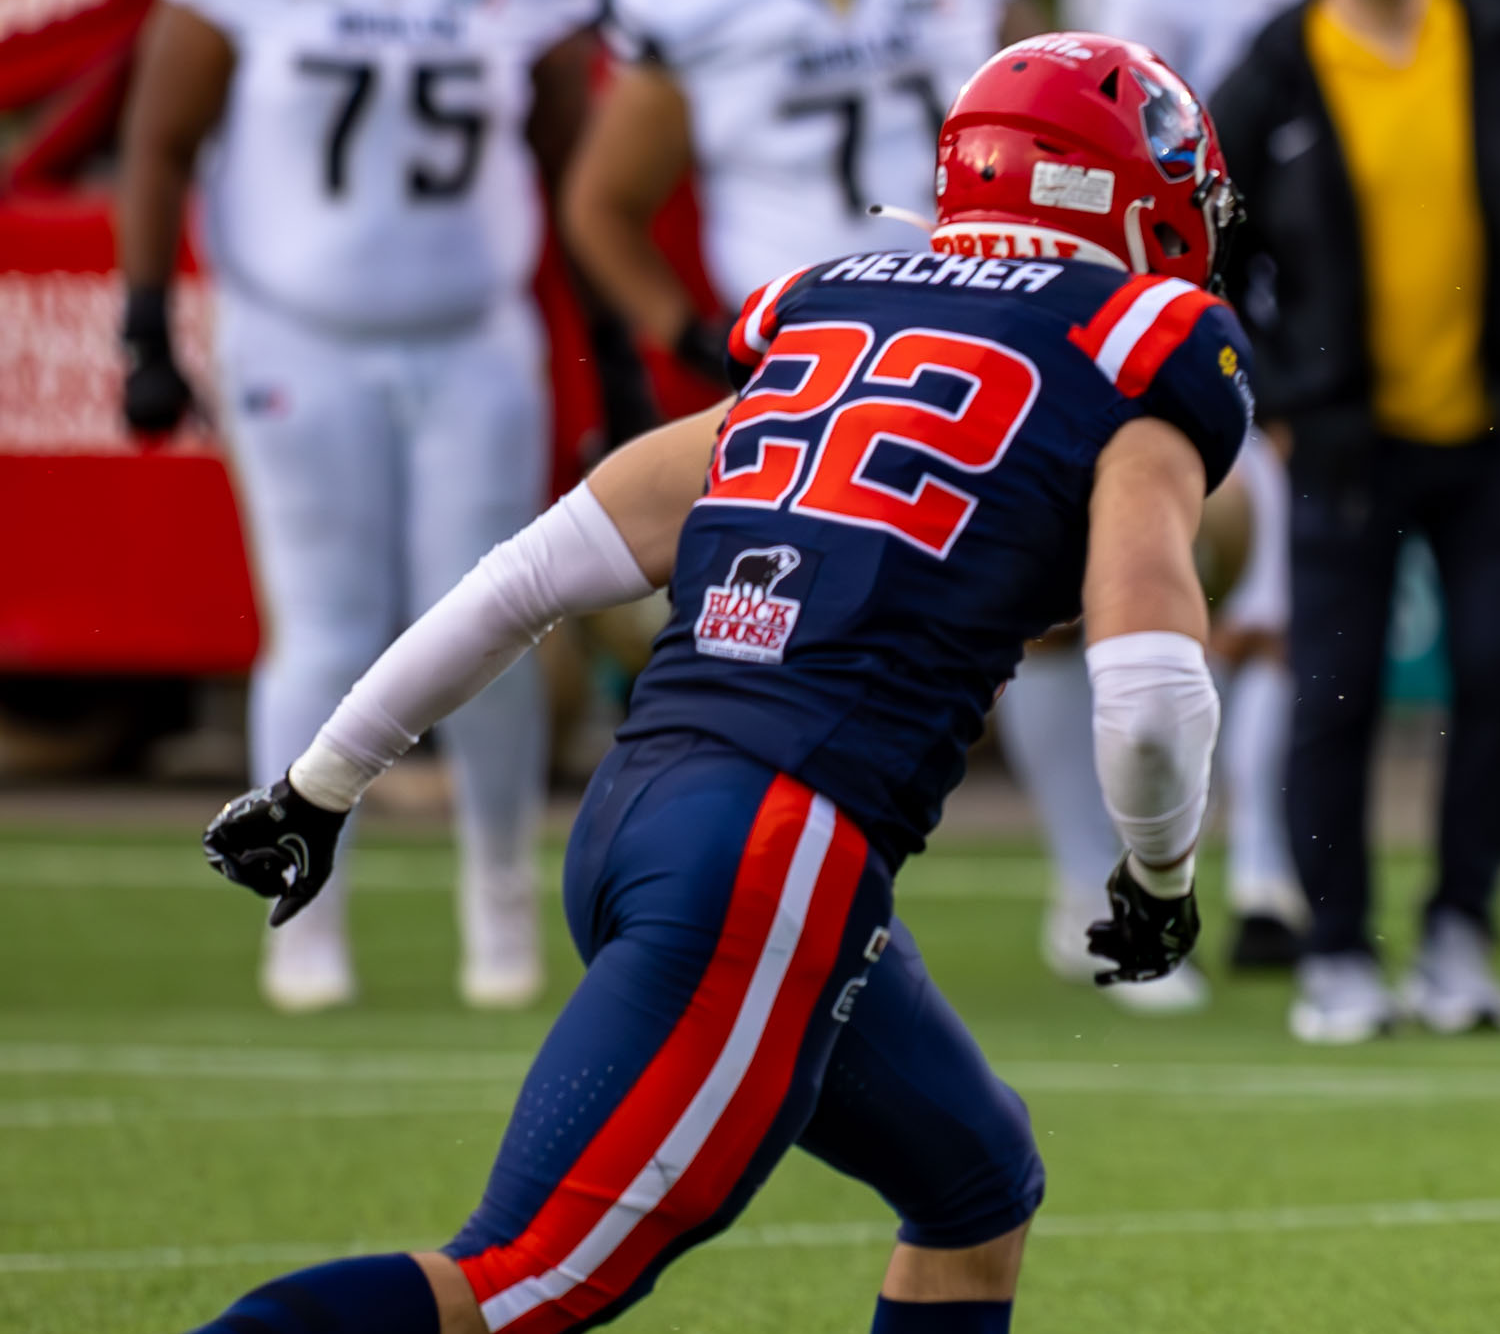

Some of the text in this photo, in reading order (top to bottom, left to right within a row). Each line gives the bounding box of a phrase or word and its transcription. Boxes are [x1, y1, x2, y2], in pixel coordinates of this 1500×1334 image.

[295, 57, 485, 200] 75
[931, 233, 1080, 259] ORELLE
[820, 251, 1064, 293] HECKER
[692, 321, 1042, 561] 22
[709, 592, 793, 627] BLOCK
[699, 618, 785, 651] HOUSE
